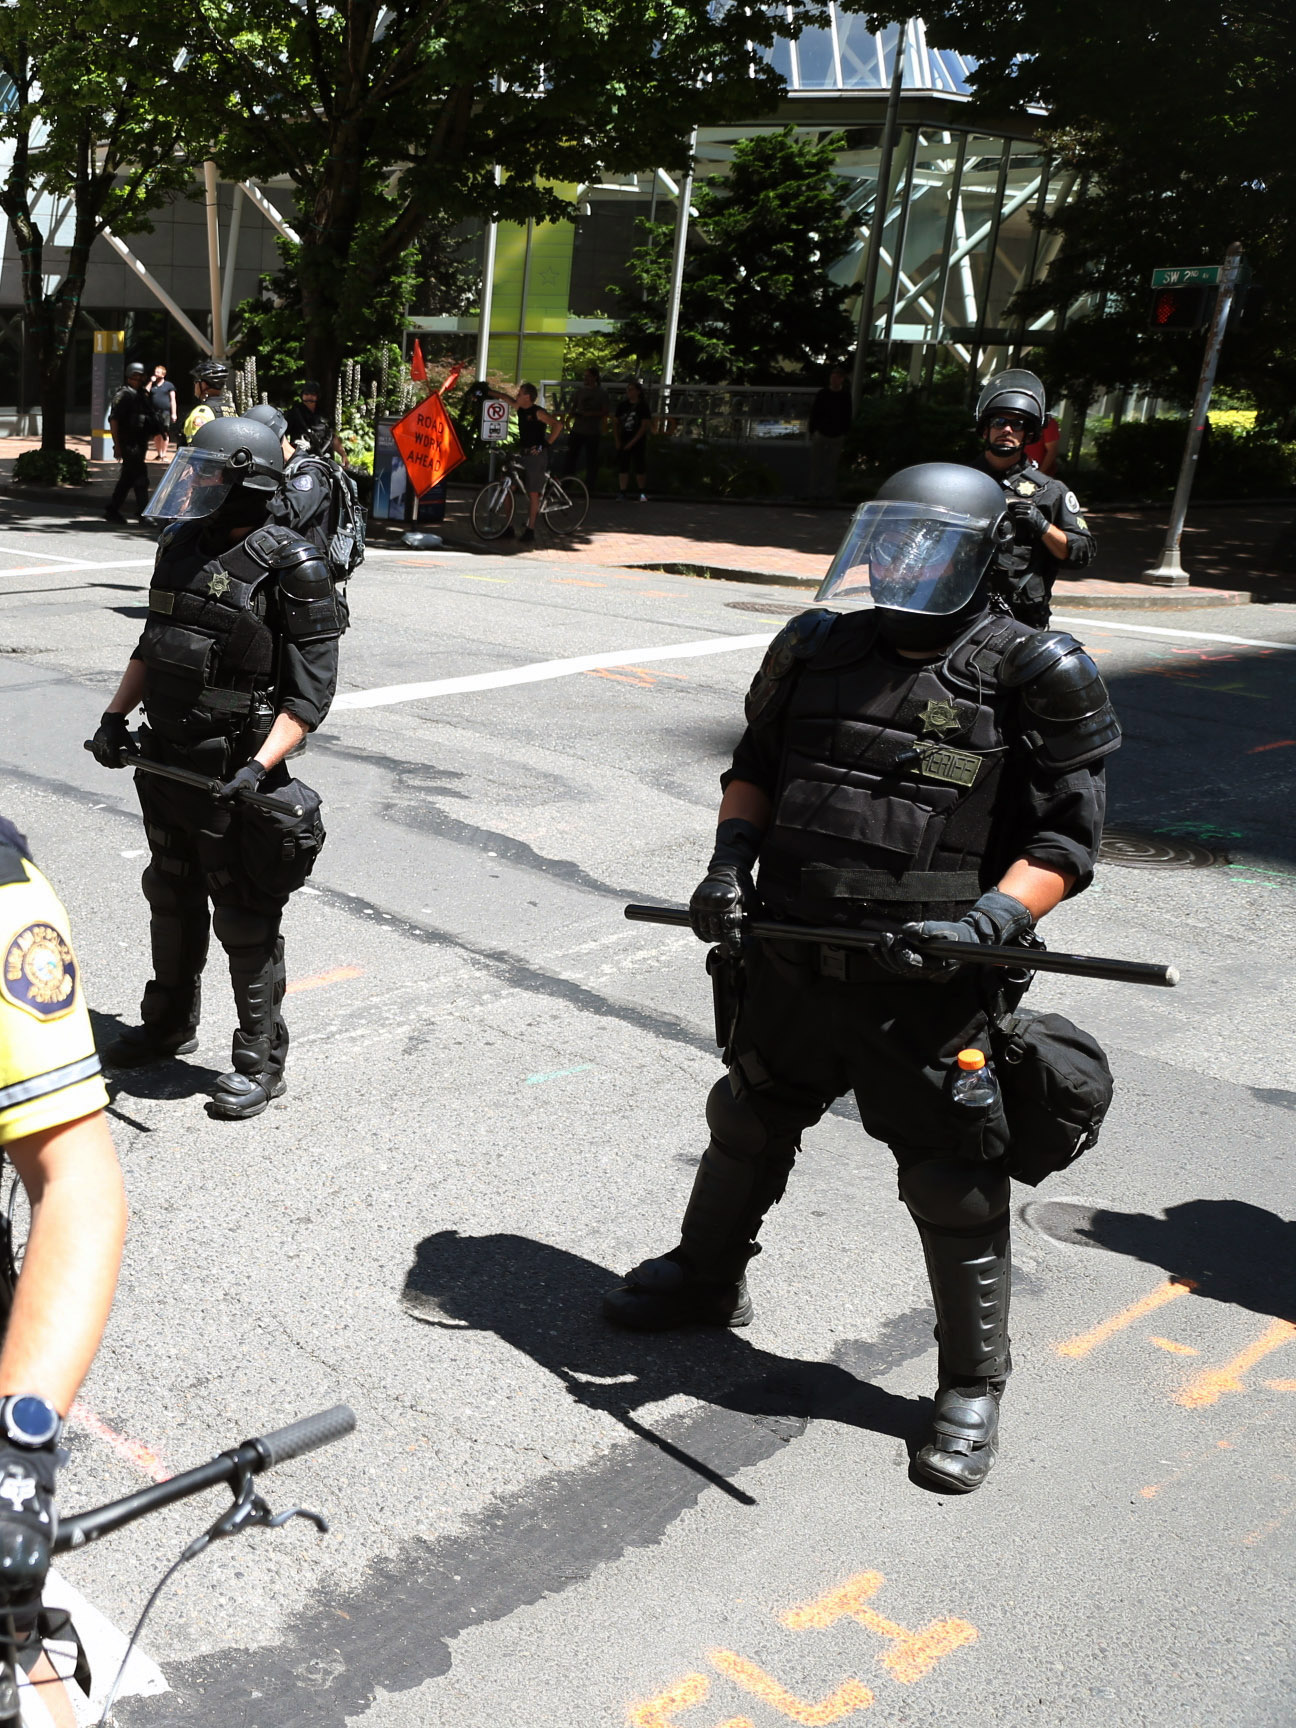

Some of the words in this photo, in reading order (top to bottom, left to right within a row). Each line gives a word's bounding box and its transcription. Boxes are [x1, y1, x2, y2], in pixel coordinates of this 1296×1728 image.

[1163, 271, 1180, 284] SW
[416, 414, 444, 434] ROAD
[415, 432, 442, 453] WORK
[407, 450, 441, 472] AHEAD
